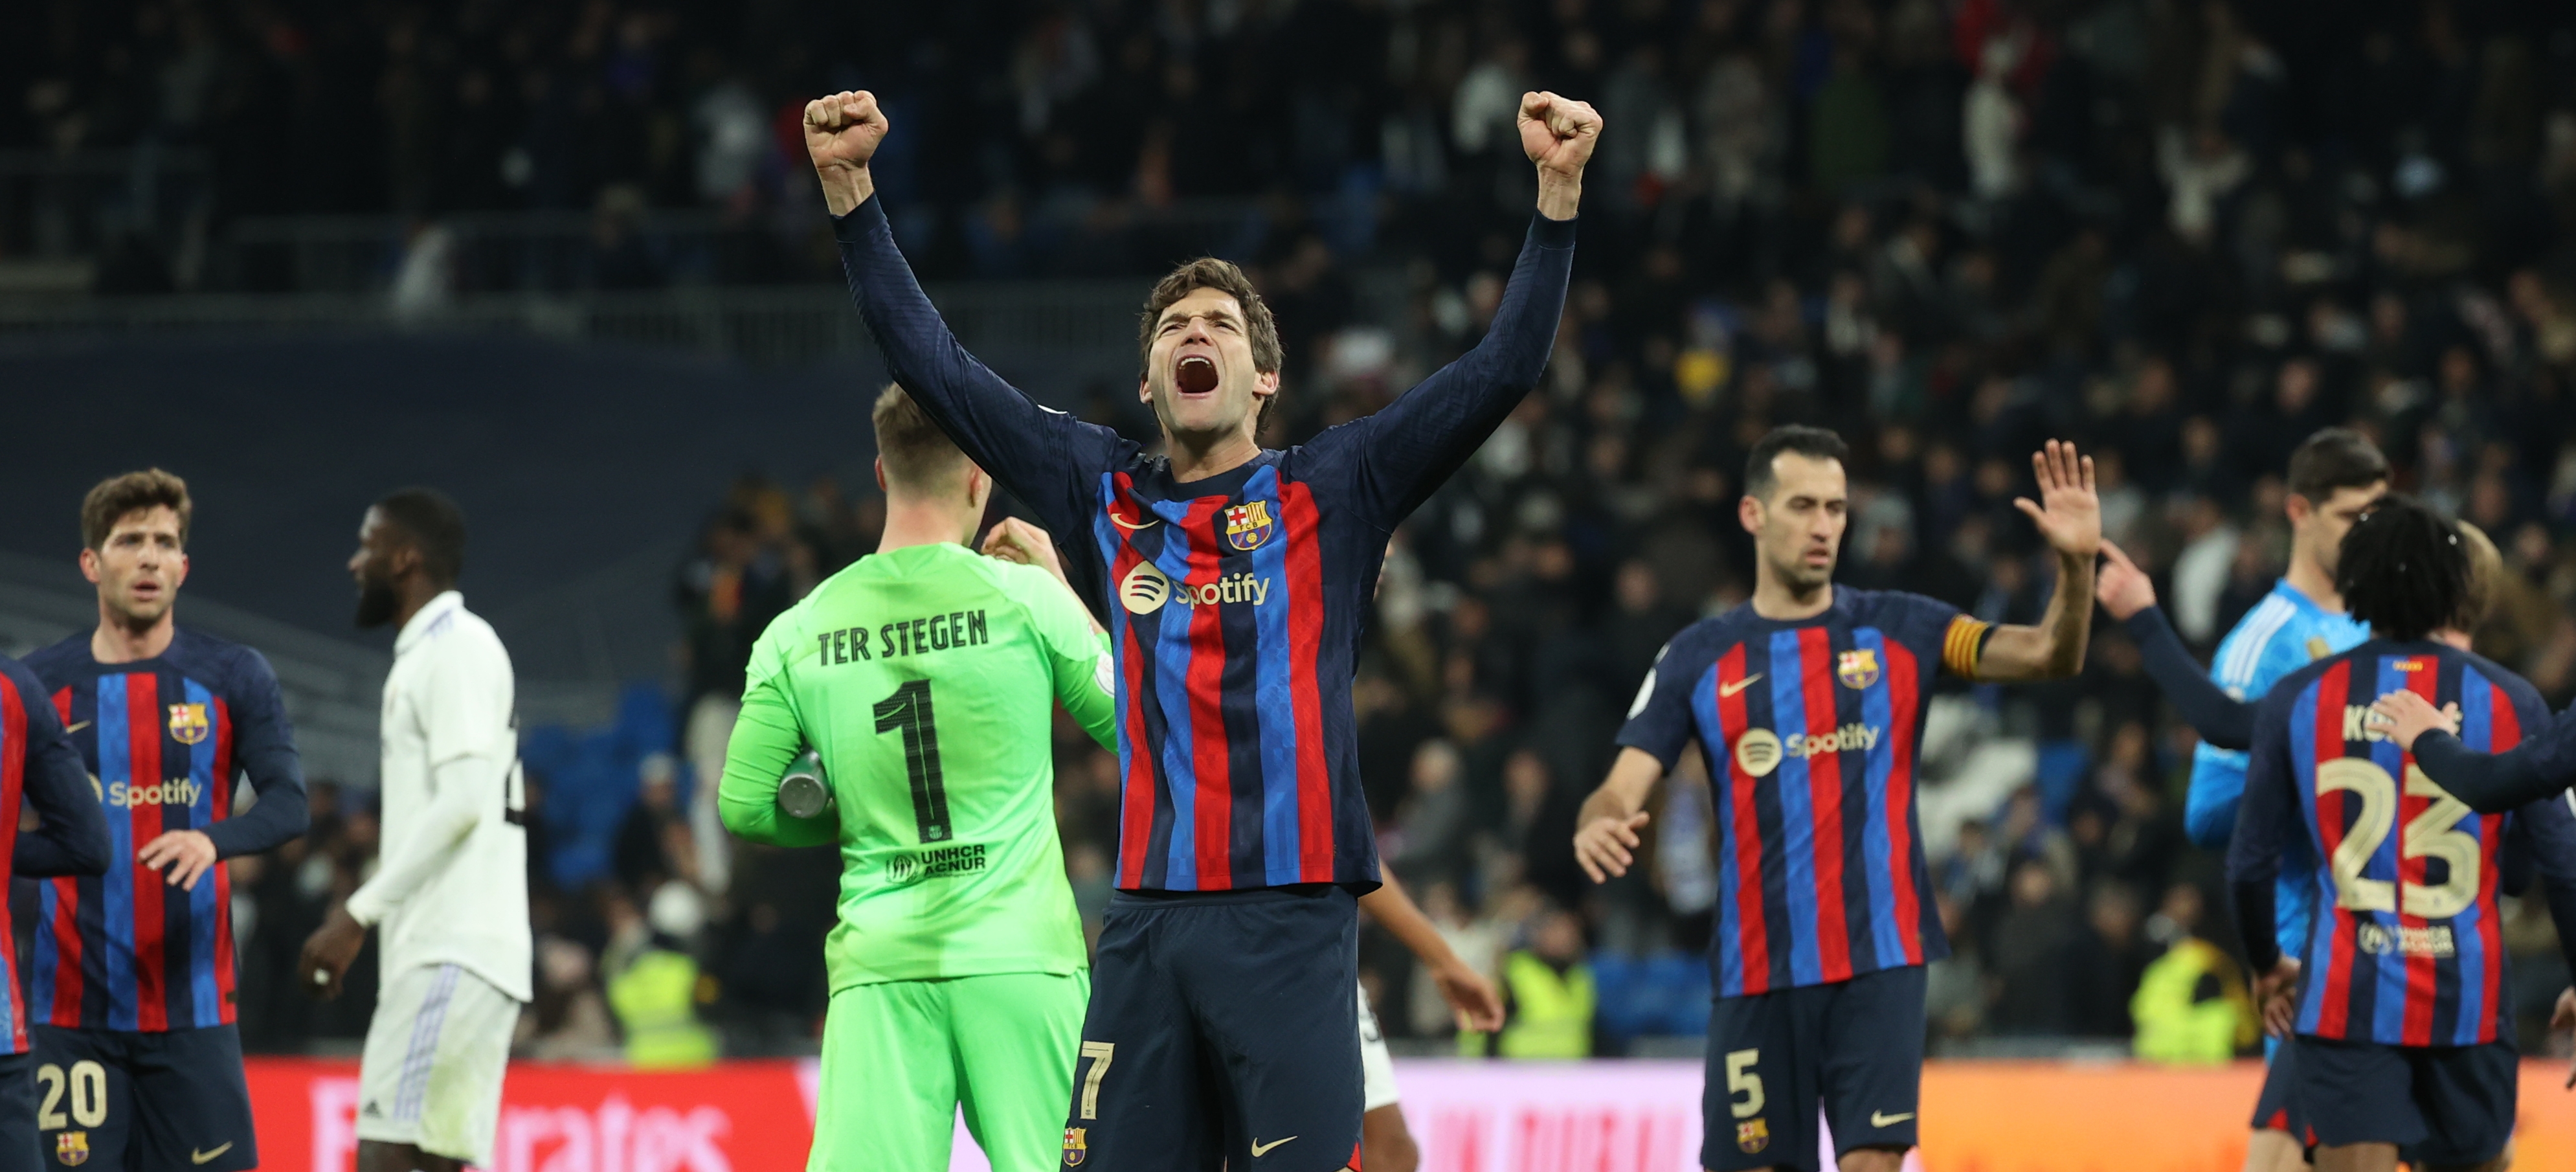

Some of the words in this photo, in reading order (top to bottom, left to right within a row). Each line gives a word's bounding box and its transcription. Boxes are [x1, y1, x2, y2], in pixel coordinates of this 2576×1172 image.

[1240, 522, 1258, 532] FCB
[1172, 572, 1271, 610] Spotify
[818, 627, 871, 667] TER
[880, 609, 989, 659] STEGEN
[873, 679, 953, 844] 1
[1786, 723, 1880, 760] Spotify
[109, 777, 202, 810] Spotify
[921, 844, 986, 864] UNHCR
[2316, 756, 2481, 919] 23
[924, 857, 986, 877] ACNUR
[36, 1059, 107, 1131] 20
[1081, 1041, 1115, 1120] 7
[1725, 1047, 1765, 1118] 5
